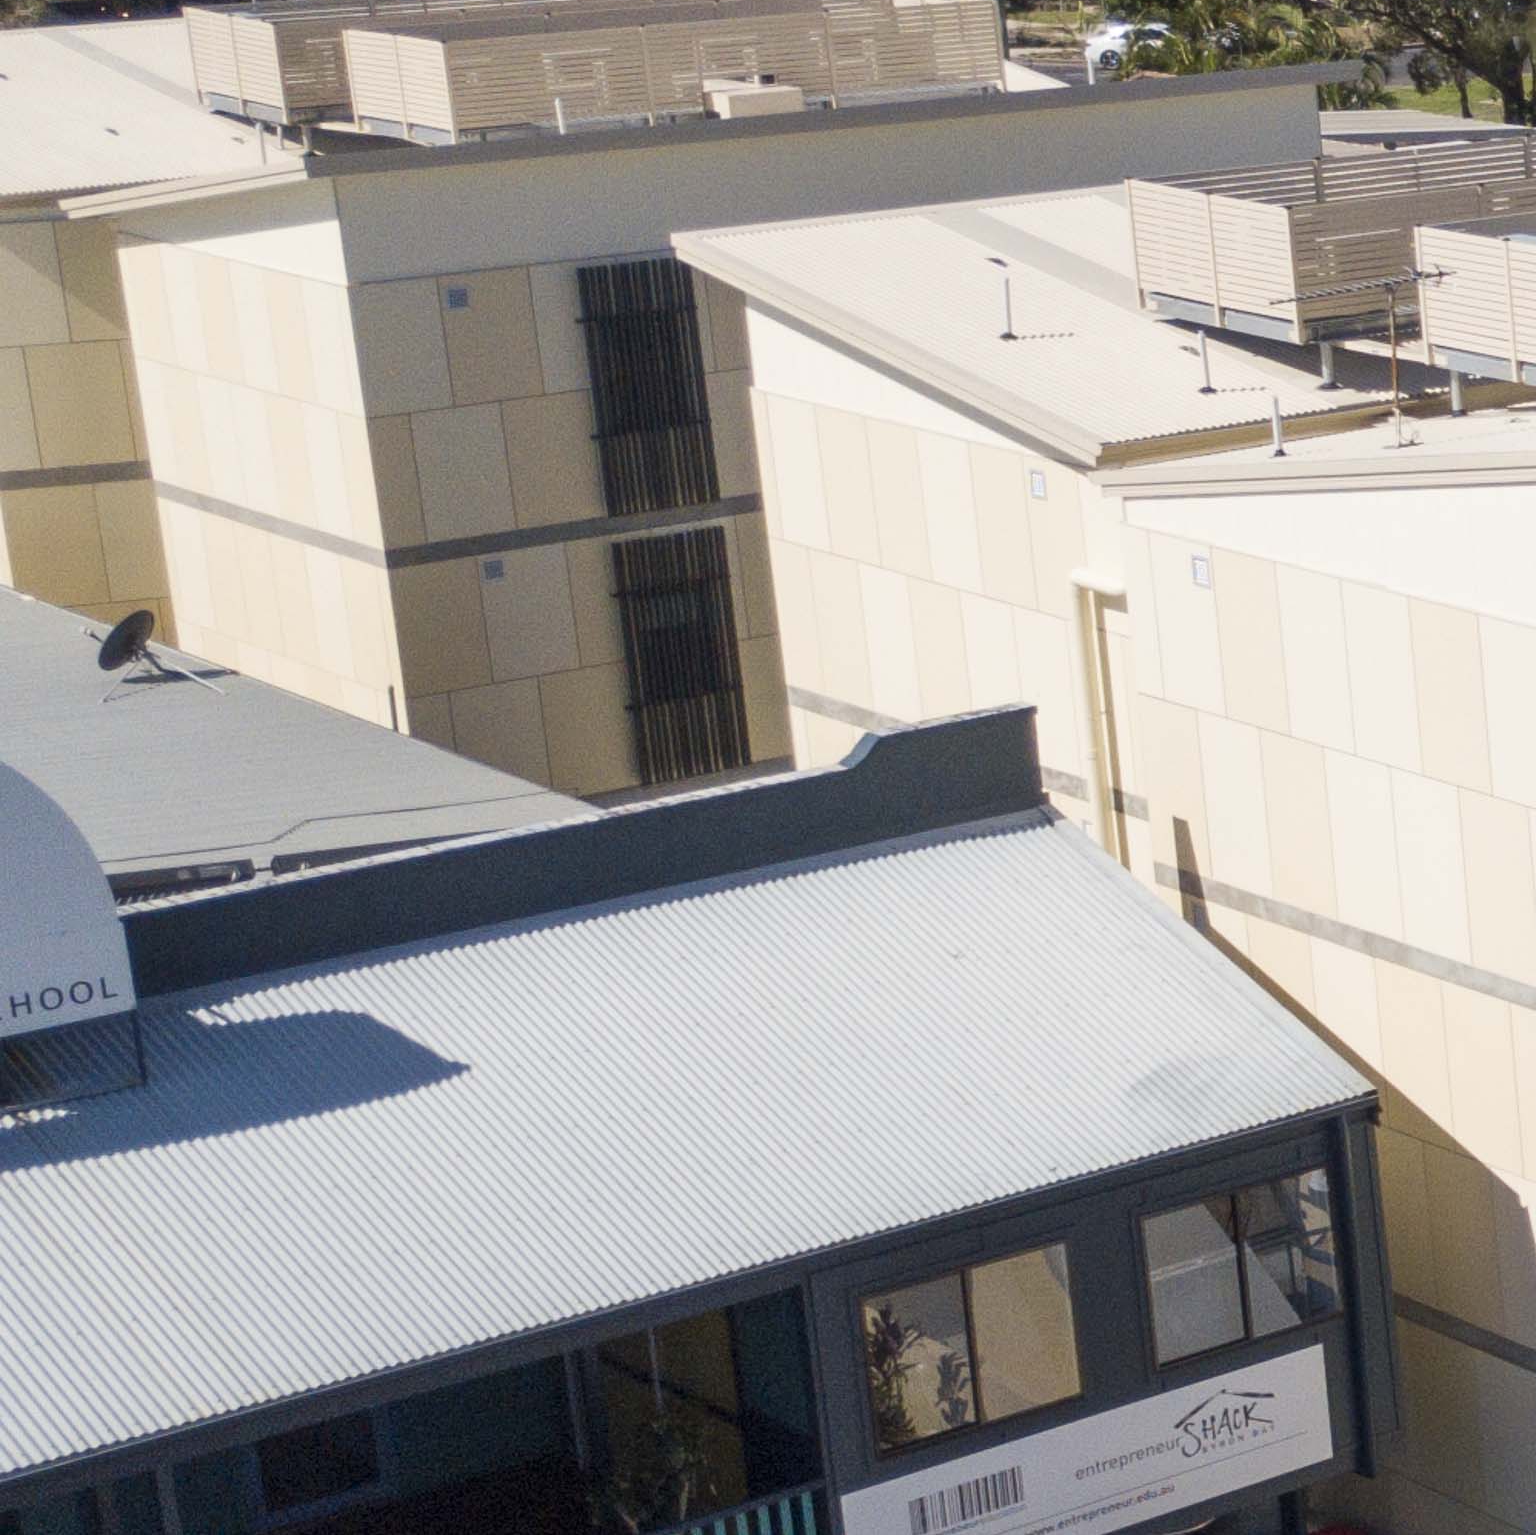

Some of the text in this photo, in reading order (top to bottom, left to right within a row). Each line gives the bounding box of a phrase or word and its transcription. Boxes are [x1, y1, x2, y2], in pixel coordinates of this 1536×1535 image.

[0, 977, 118, 1019] HOOL
[1075, 1401, 1273, 1481] entrepreneur SHACK
